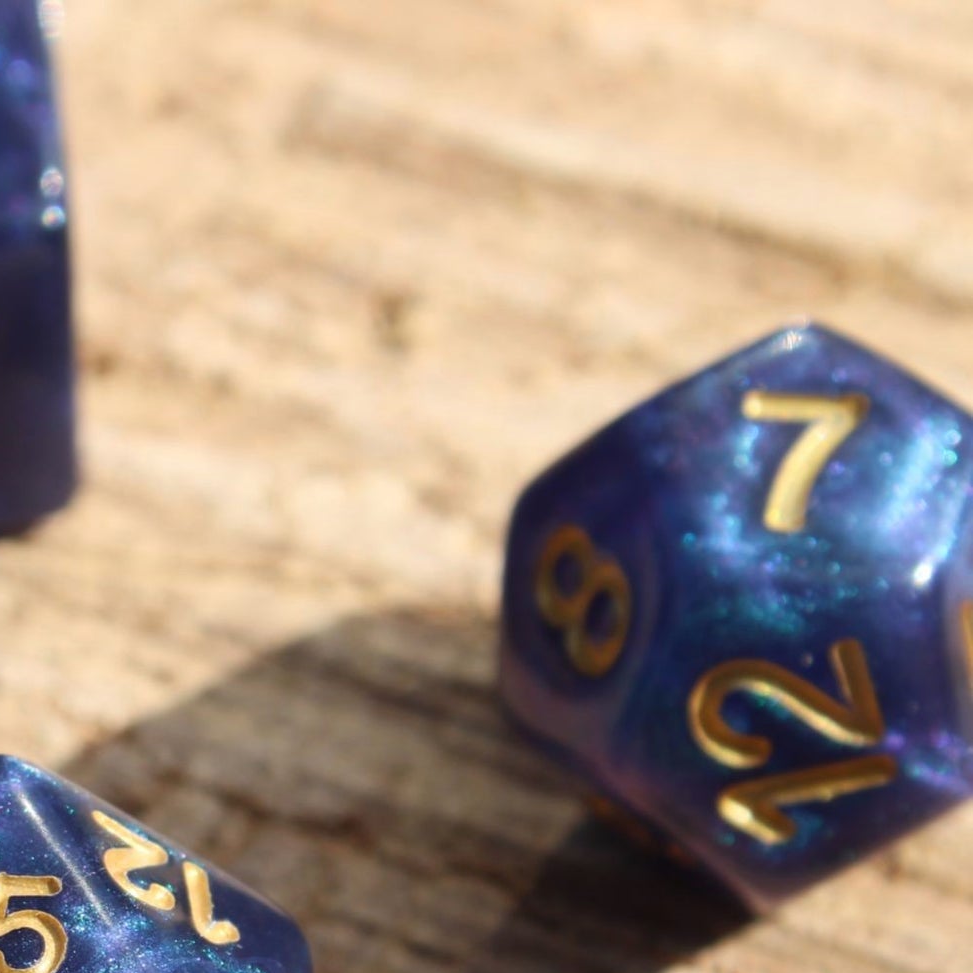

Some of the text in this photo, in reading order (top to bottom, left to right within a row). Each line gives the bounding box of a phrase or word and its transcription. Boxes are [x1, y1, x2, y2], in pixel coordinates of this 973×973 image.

[741, 391, 869, 533] 7
[535, 525, 631, 677] 8
[688, 638, 896, 845] 12
[93, 810, 240, 945] 12
